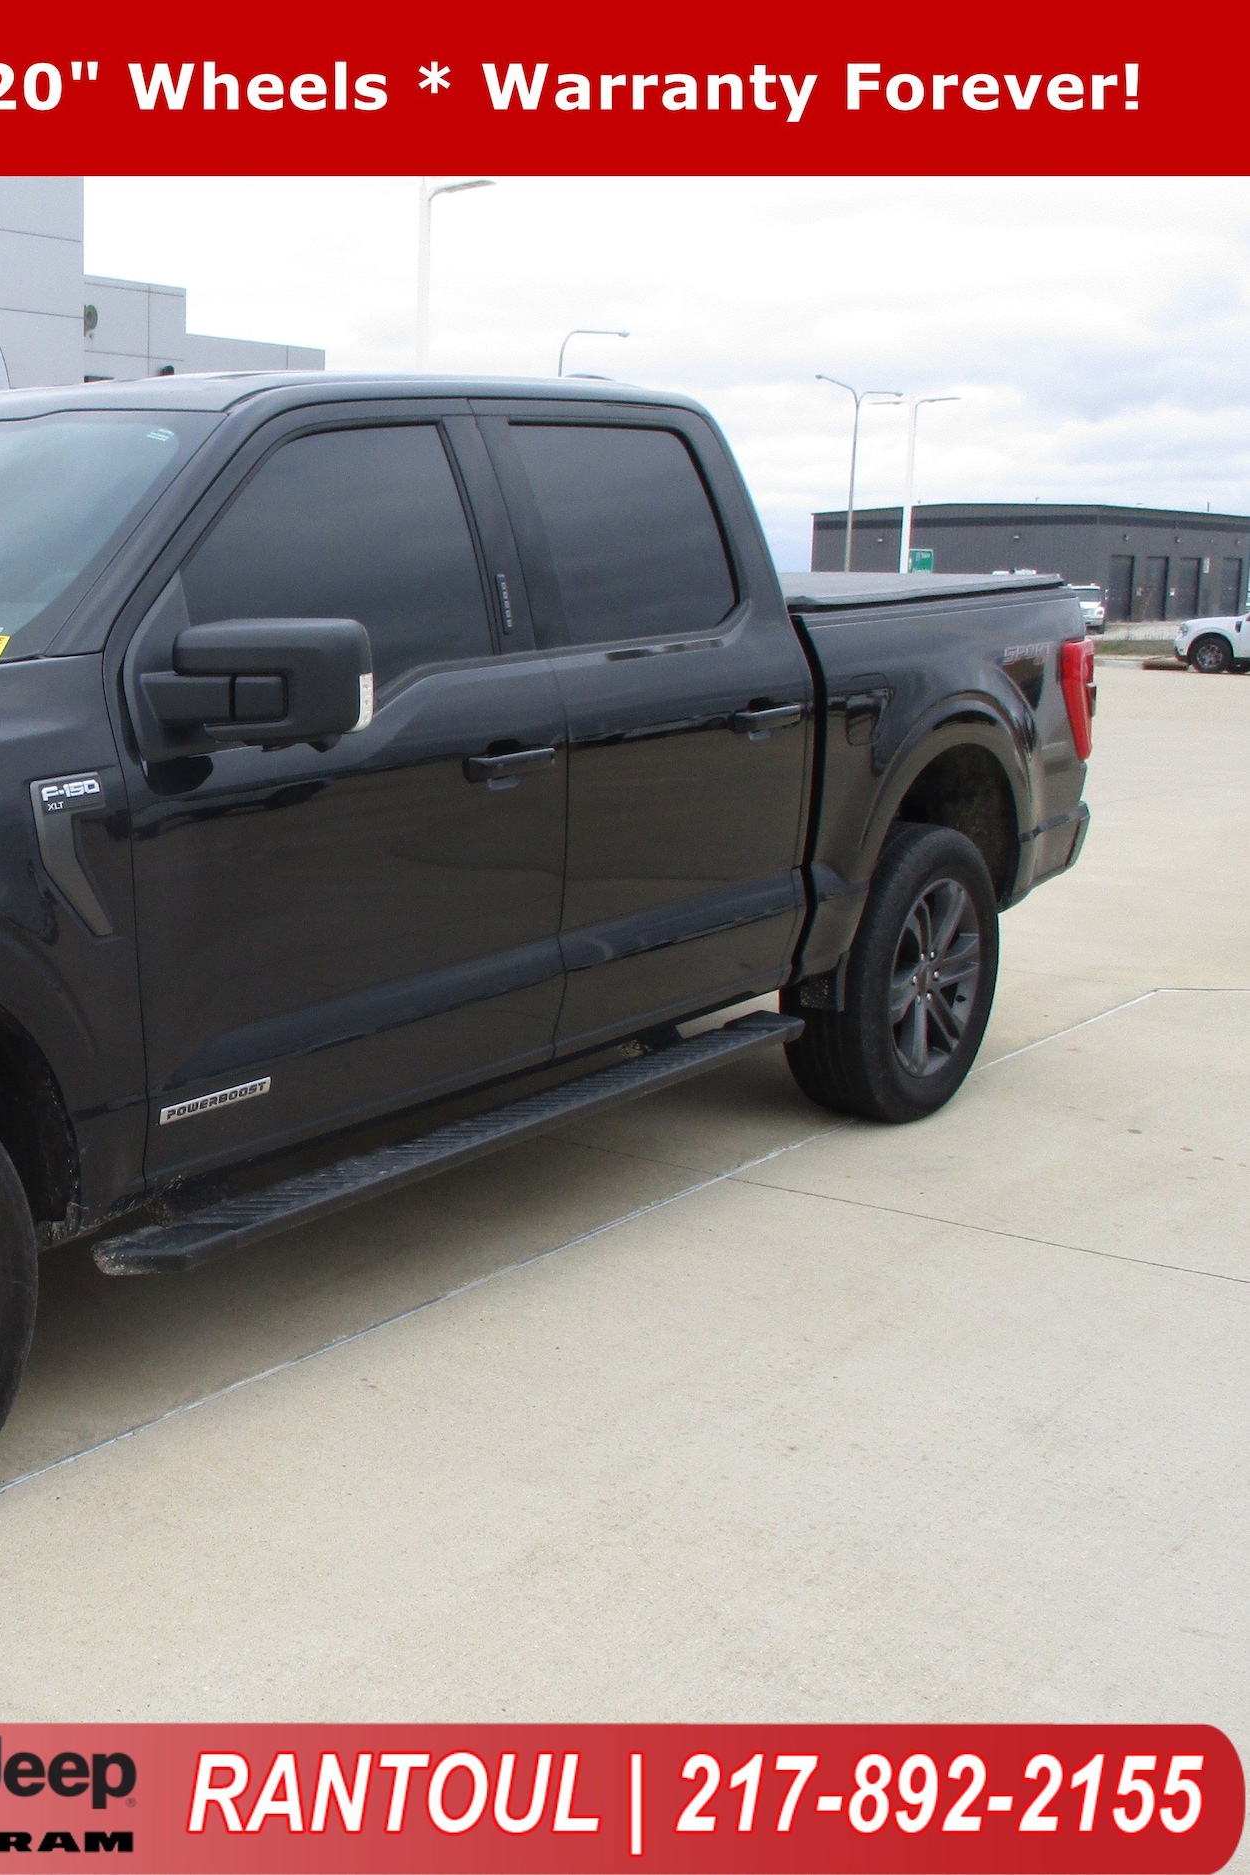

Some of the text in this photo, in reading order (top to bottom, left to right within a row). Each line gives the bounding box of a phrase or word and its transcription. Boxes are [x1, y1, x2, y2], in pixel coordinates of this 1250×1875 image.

[41, 779, 100, 802] F-150
[47, 801, 64, 811] XLT
[167, 1081, 266, 1120] POWERBOOST
